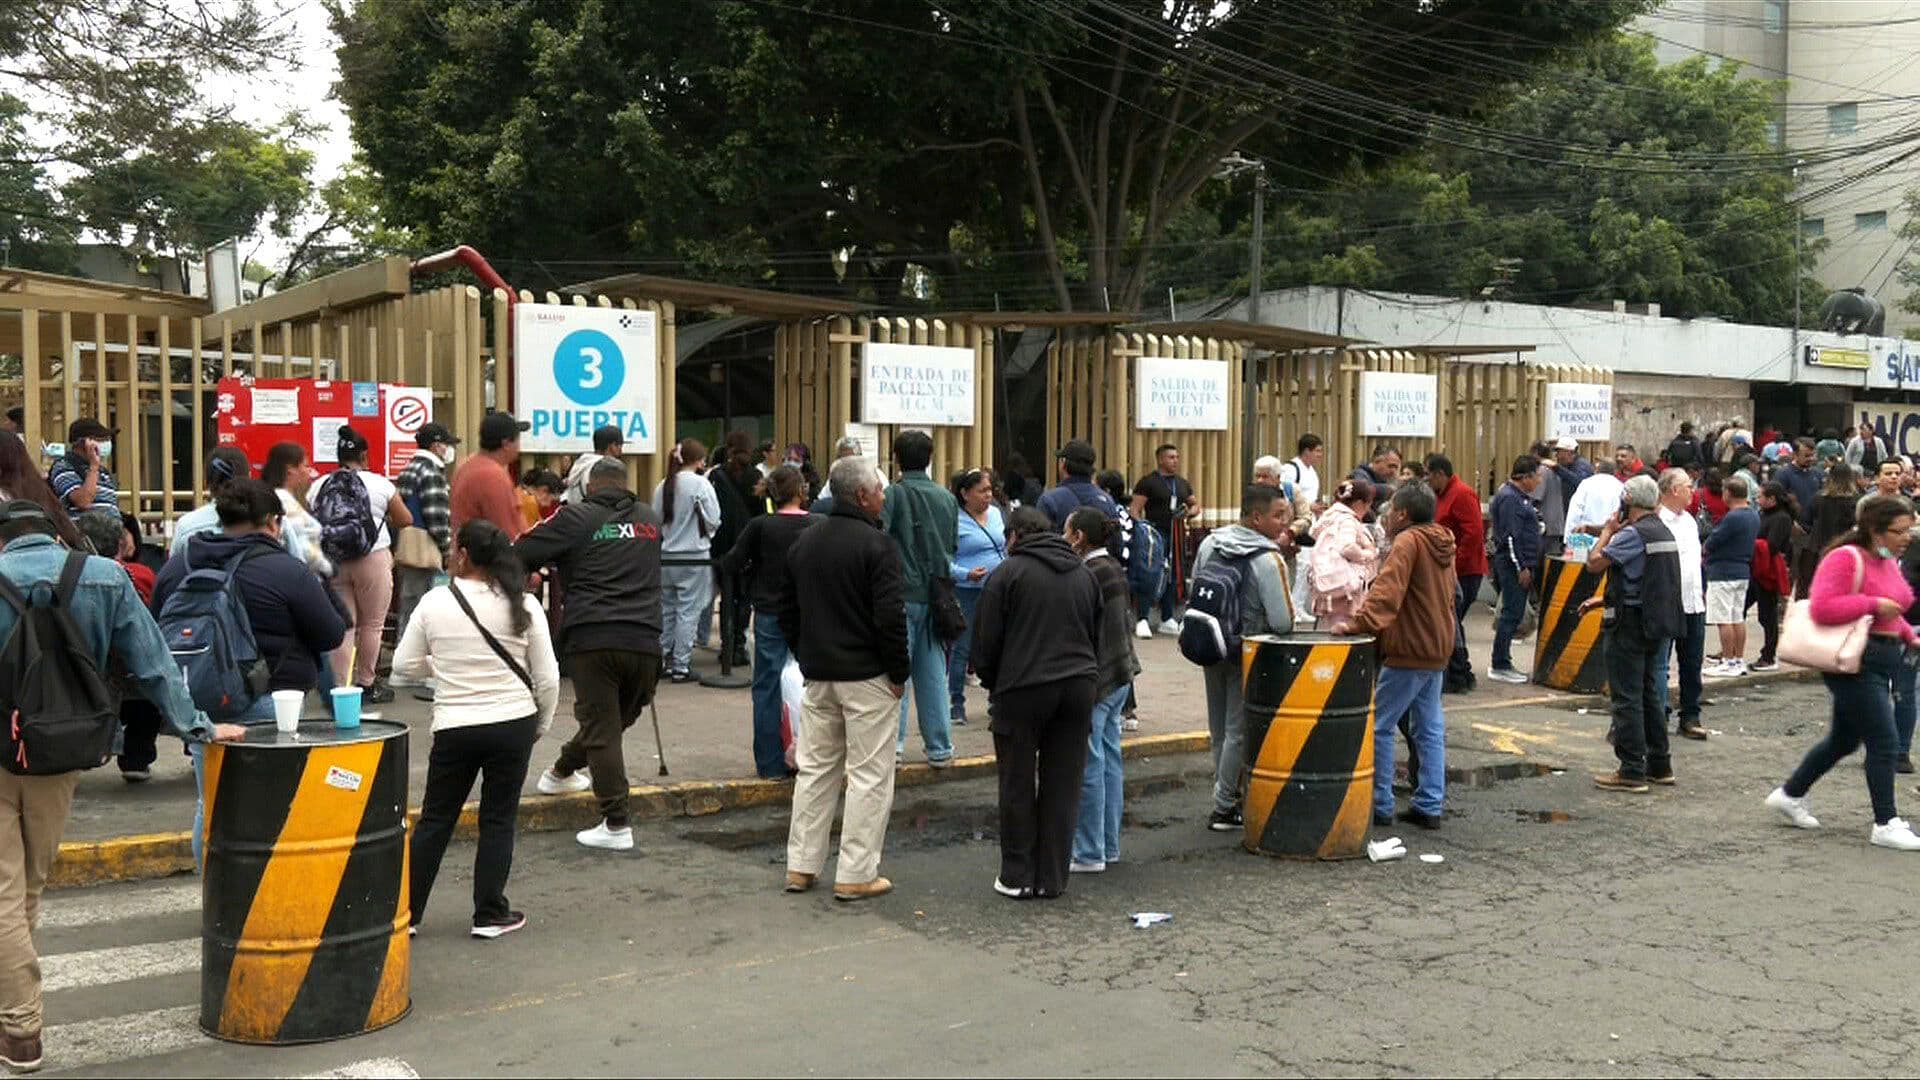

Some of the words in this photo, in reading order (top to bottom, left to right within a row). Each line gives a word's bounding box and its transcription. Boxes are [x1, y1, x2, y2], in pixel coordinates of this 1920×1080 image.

[579, 347, 603, 389] 3
[871, 365, 944, 382] ENTRADA
[951, 369, 971, 383] DE
[878, 382, 966, 398] PACIENTES
[1151, 377, 1198, 390] SALIDA
[1203, 378, 1217, 391] DE
[1151, 391, 1221, 404] PACIENTES
[1374, 389, 1411, 401] SALIDA
[1414, 390, 1427, 402] DE
[1375, 401, 1428, 414] PERSONAL
[1554, 399, 1597, 410] ENTRADA
[532, 409, 648, 438] PUERTA
[1559, 411, 1605, 423] PERSONAL
[593, 521, 657, 541] MEXICO
